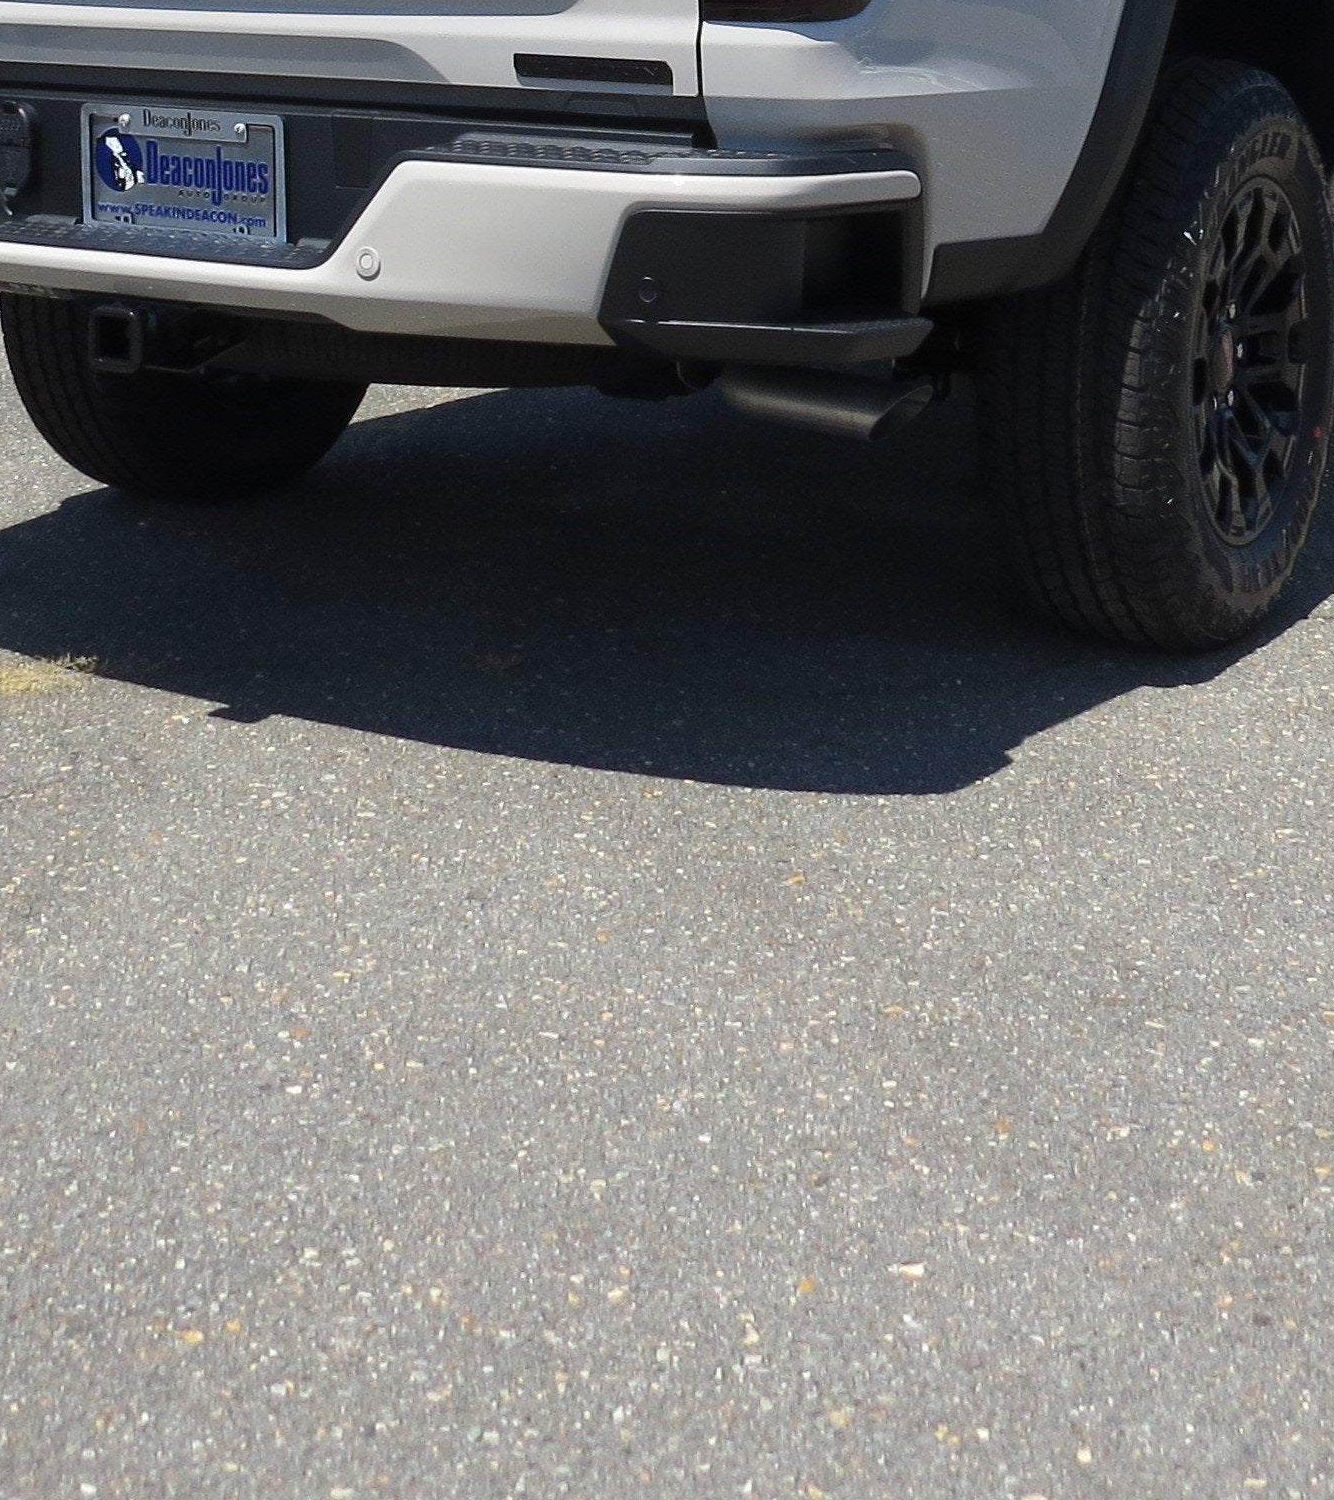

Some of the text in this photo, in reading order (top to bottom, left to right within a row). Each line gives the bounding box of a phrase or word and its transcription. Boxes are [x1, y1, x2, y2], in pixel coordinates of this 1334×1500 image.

[178, 190, 265, 203] AUTO GROUP
[98, 202, 267, 228] www.SPEAKINDEACON.com
